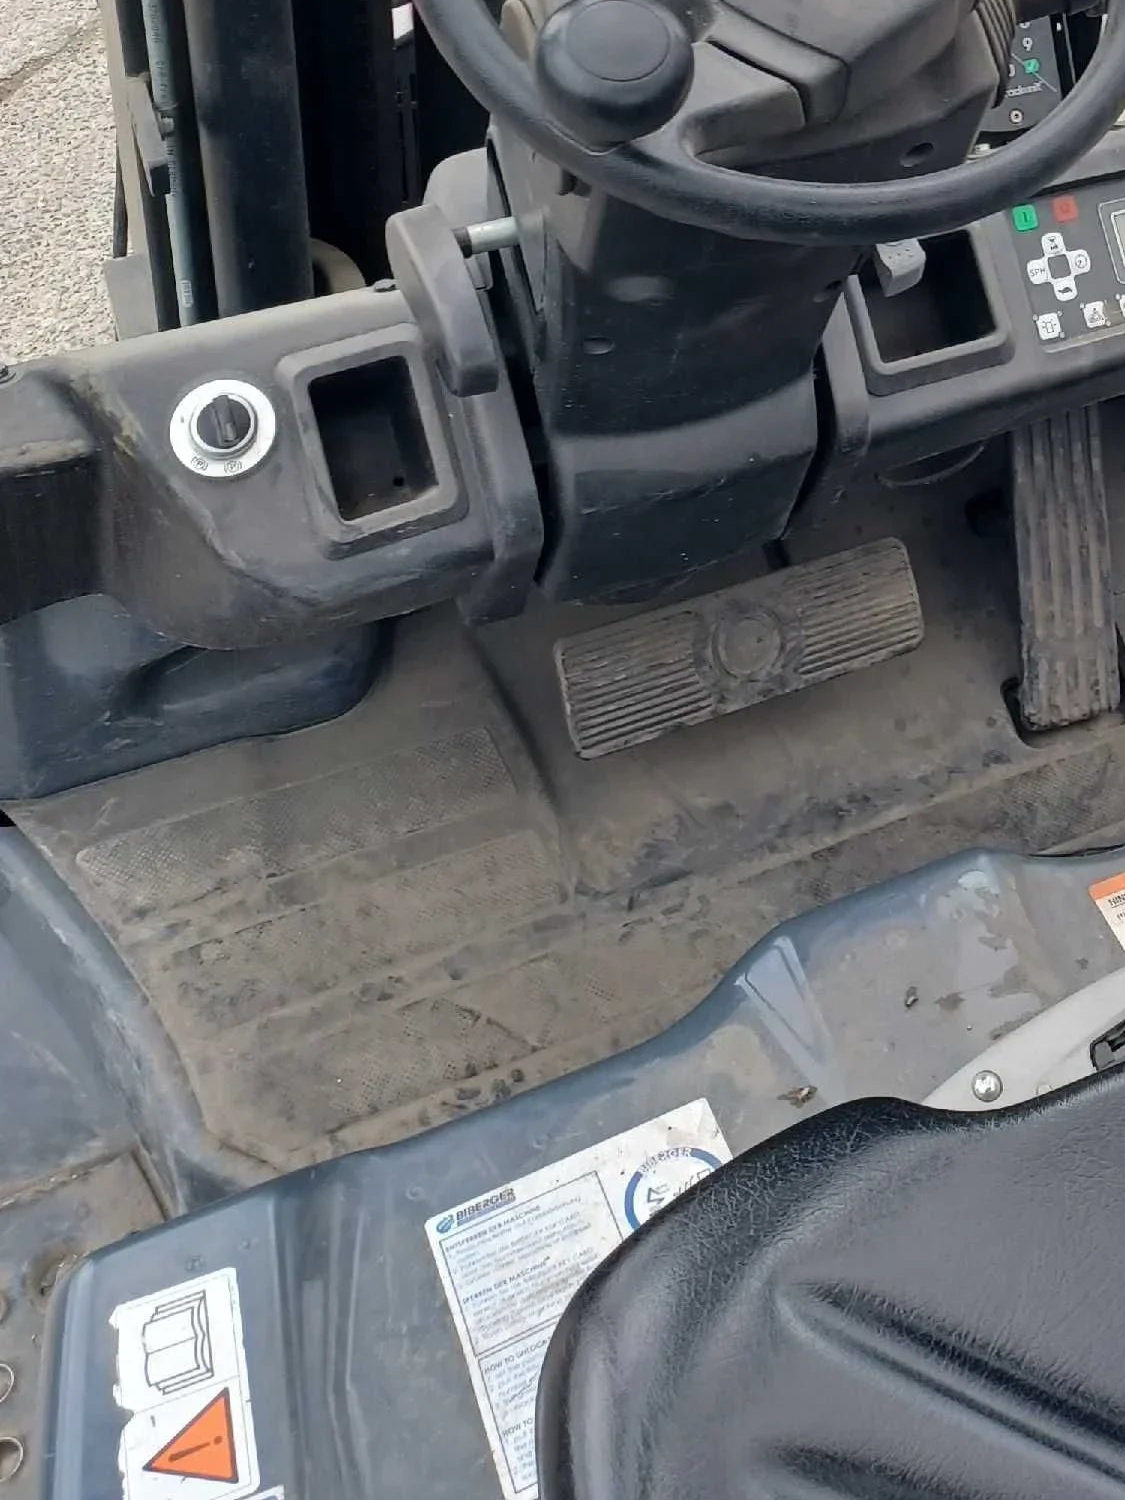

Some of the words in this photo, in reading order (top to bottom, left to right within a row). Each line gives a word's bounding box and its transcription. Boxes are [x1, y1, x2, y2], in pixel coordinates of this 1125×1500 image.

[457, 1188, 515, 1219] BIBERGER
[484, 1360, 502, 1374] HOW
[503, 1422, 522, 1437] HOW
